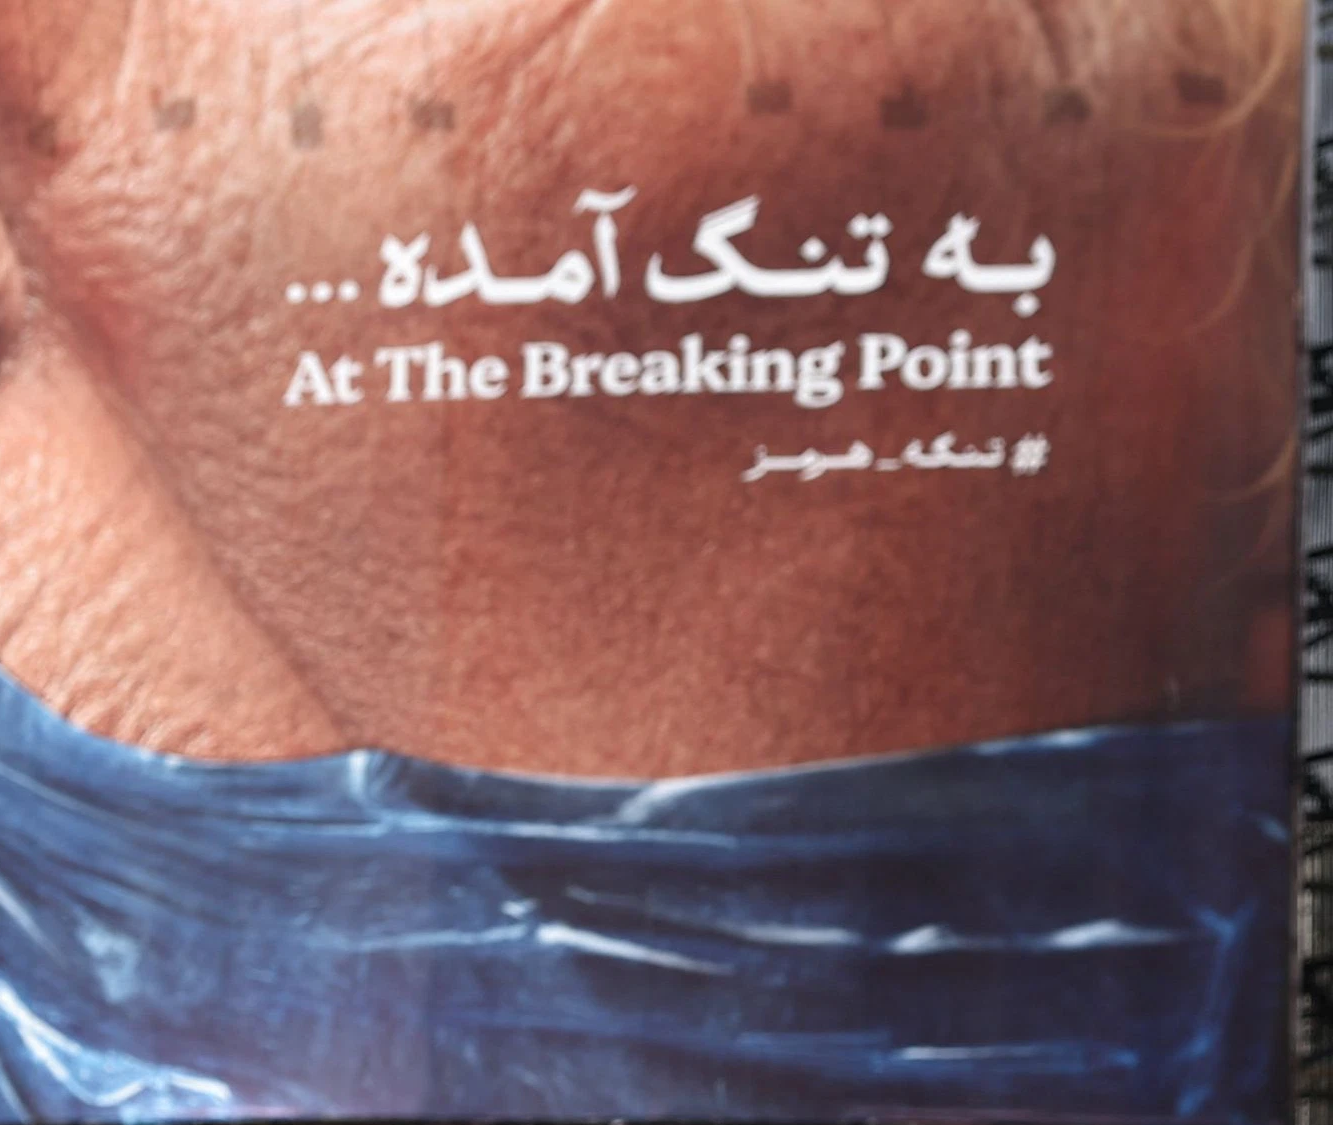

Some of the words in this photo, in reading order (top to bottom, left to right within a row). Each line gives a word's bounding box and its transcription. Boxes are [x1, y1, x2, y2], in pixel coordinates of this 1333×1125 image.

[378, 183, 638, 308] آمده
[643, 195, 893, 304] تنگ
[922, 212, 1056, 317] به
[283, 349, 365, 406] At
[375, 341, 508, 402] The
[521, 332, 844, 408] Breaking
[858, 329, 1054, 390] Point
